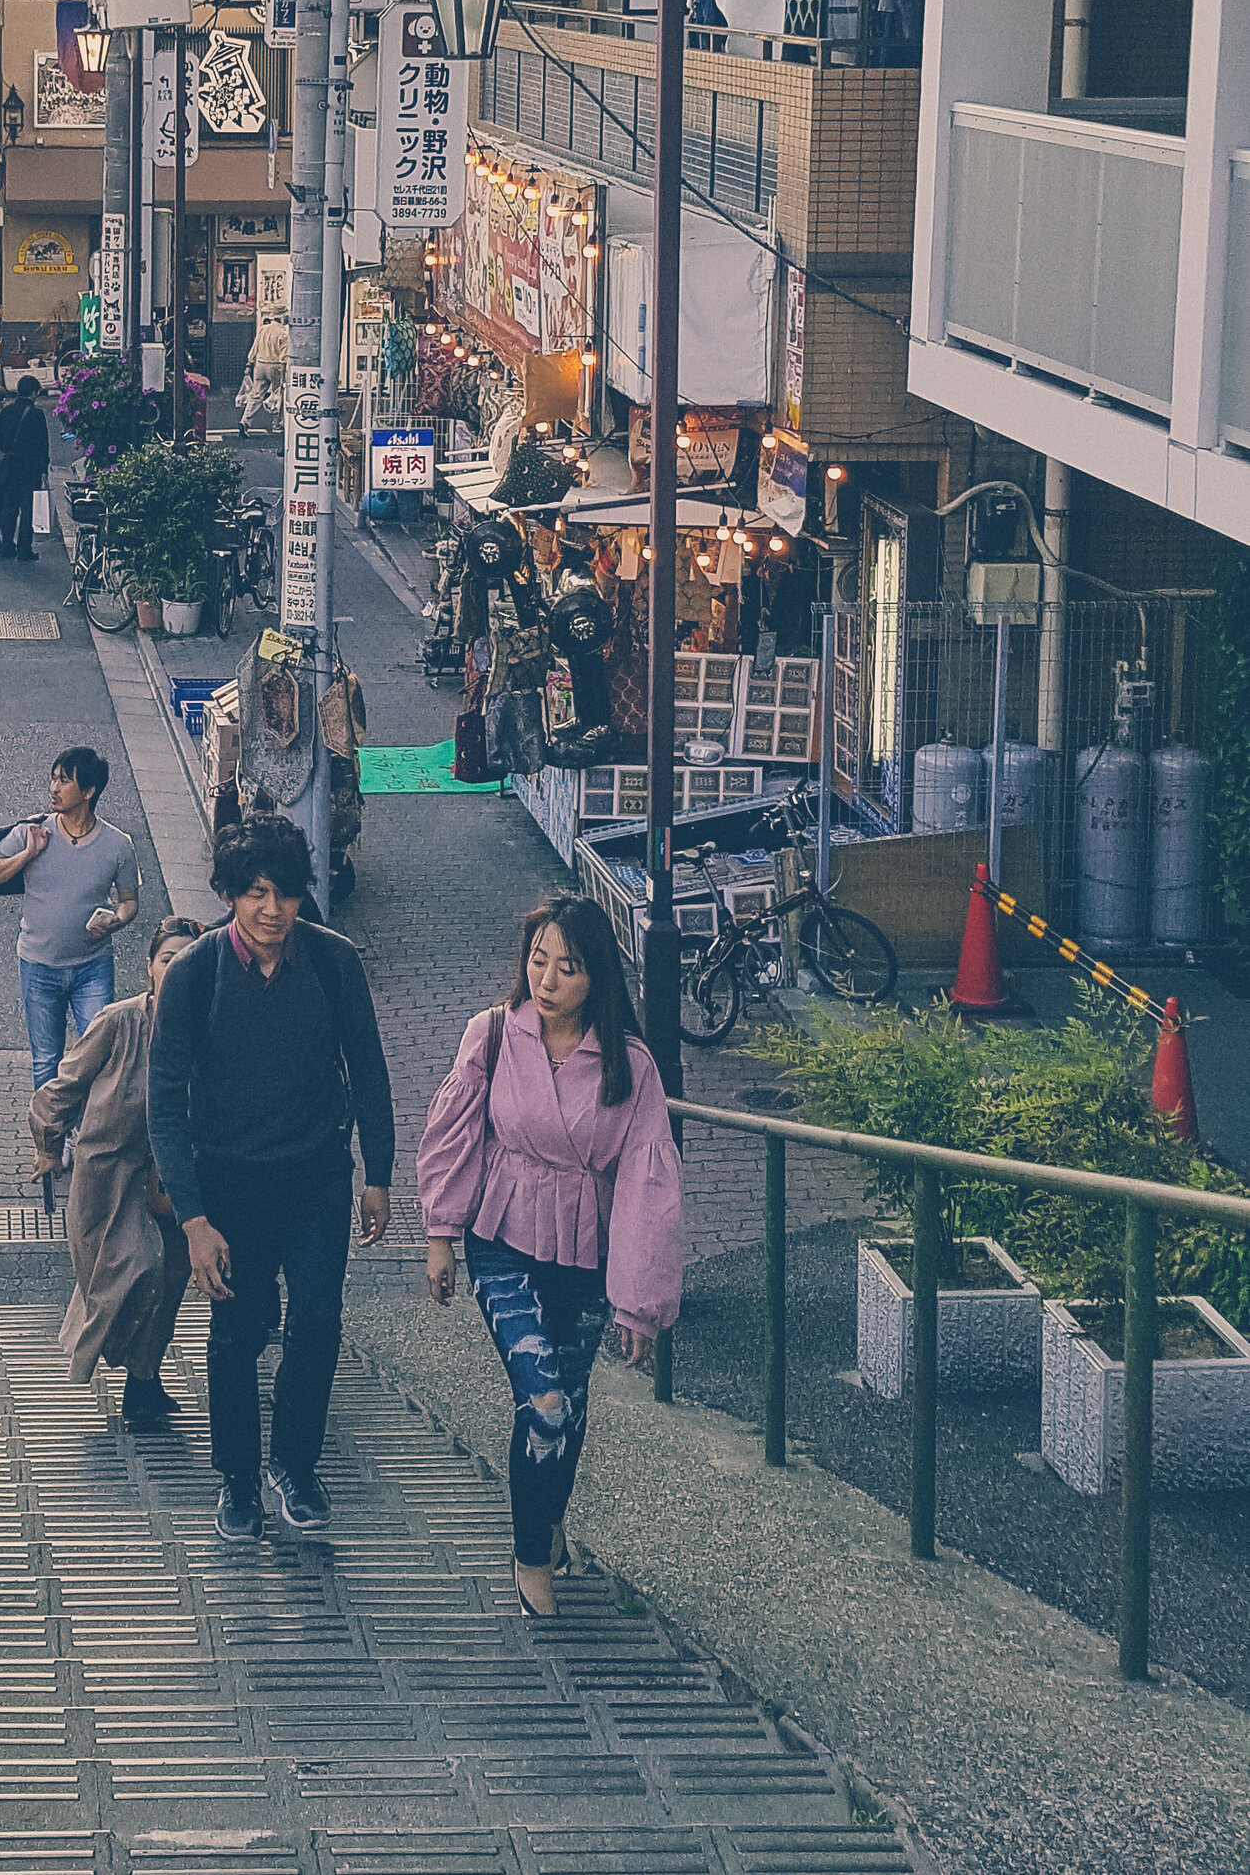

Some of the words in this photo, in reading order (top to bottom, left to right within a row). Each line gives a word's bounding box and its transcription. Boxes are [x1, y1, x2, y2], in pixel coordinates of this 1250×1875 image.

[395, 62, 421, 180] クリニック
[421, 62, 450, 181] 動物・野沢
[391, 208, 448, 218] 3894-7739
[386, 432, 419, 445] Asahi
[382, 454, 426, 474] 焼肉
[381, 478, 427, 486] サラリーマン
